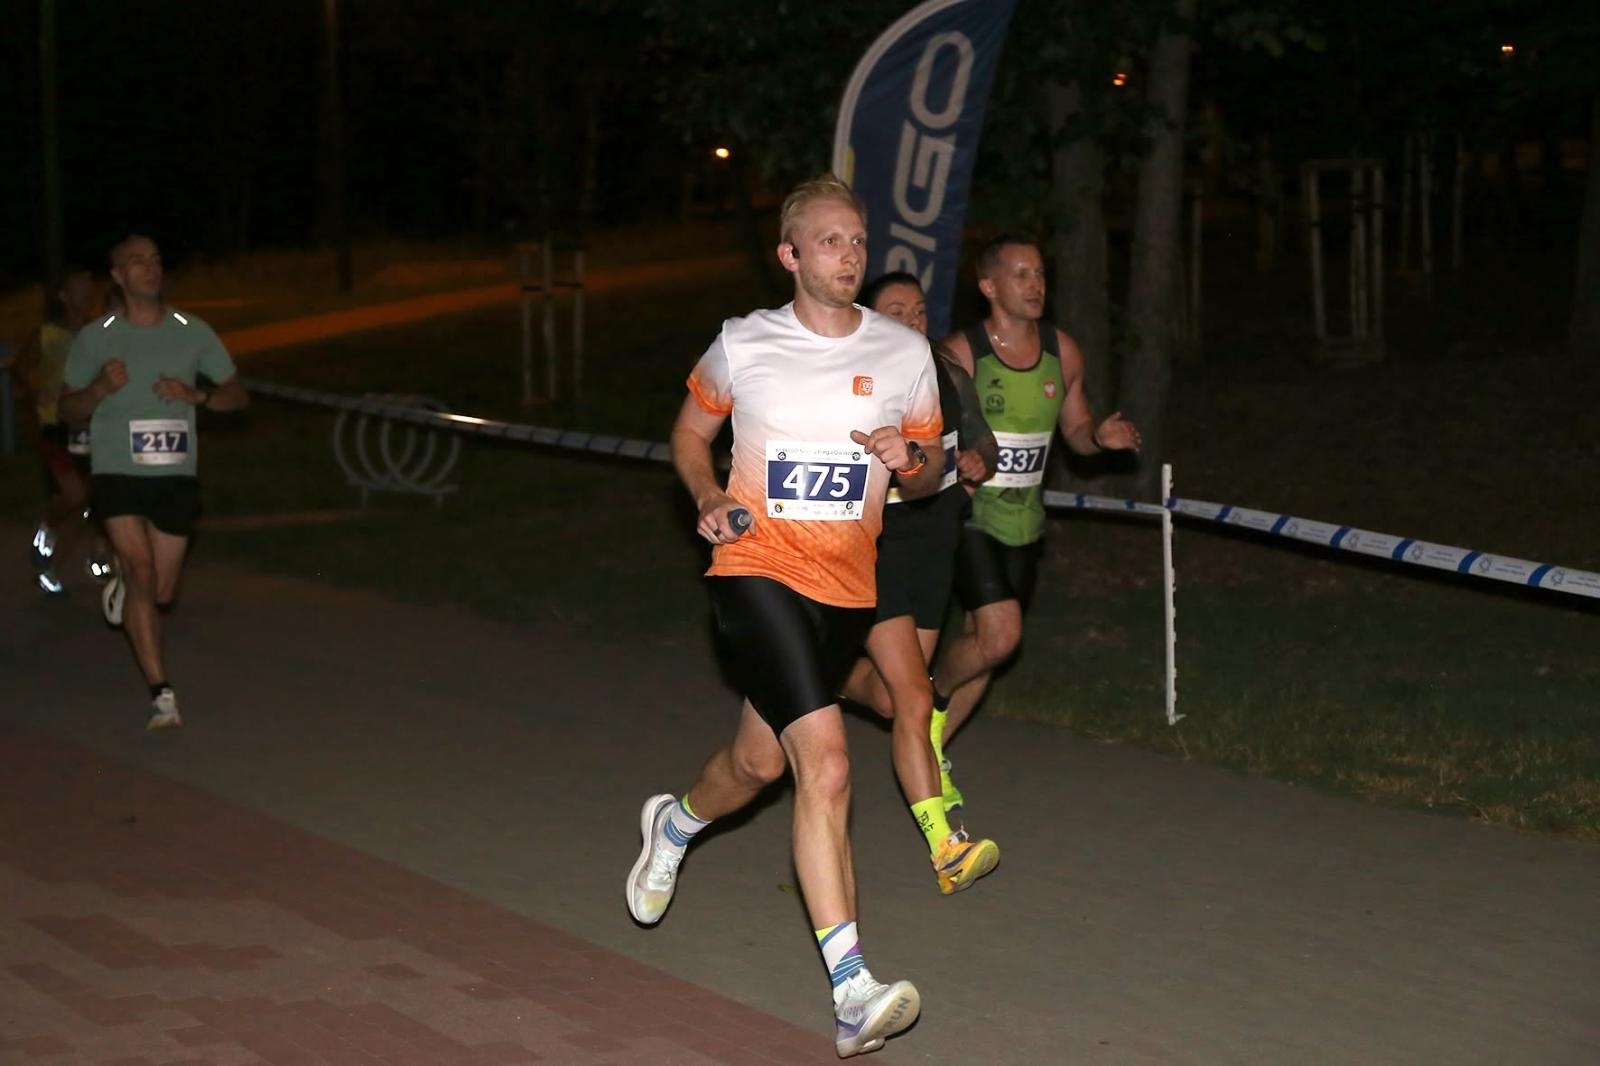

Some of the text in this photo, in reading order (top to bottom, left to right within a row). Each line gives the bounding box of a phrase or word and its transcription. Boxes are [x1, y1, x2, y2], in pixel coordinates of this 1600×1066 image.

[142, 432, 181, 452] 217
[997, 448, 1041, 472] 337
[782, 464, 851, 498] 475
